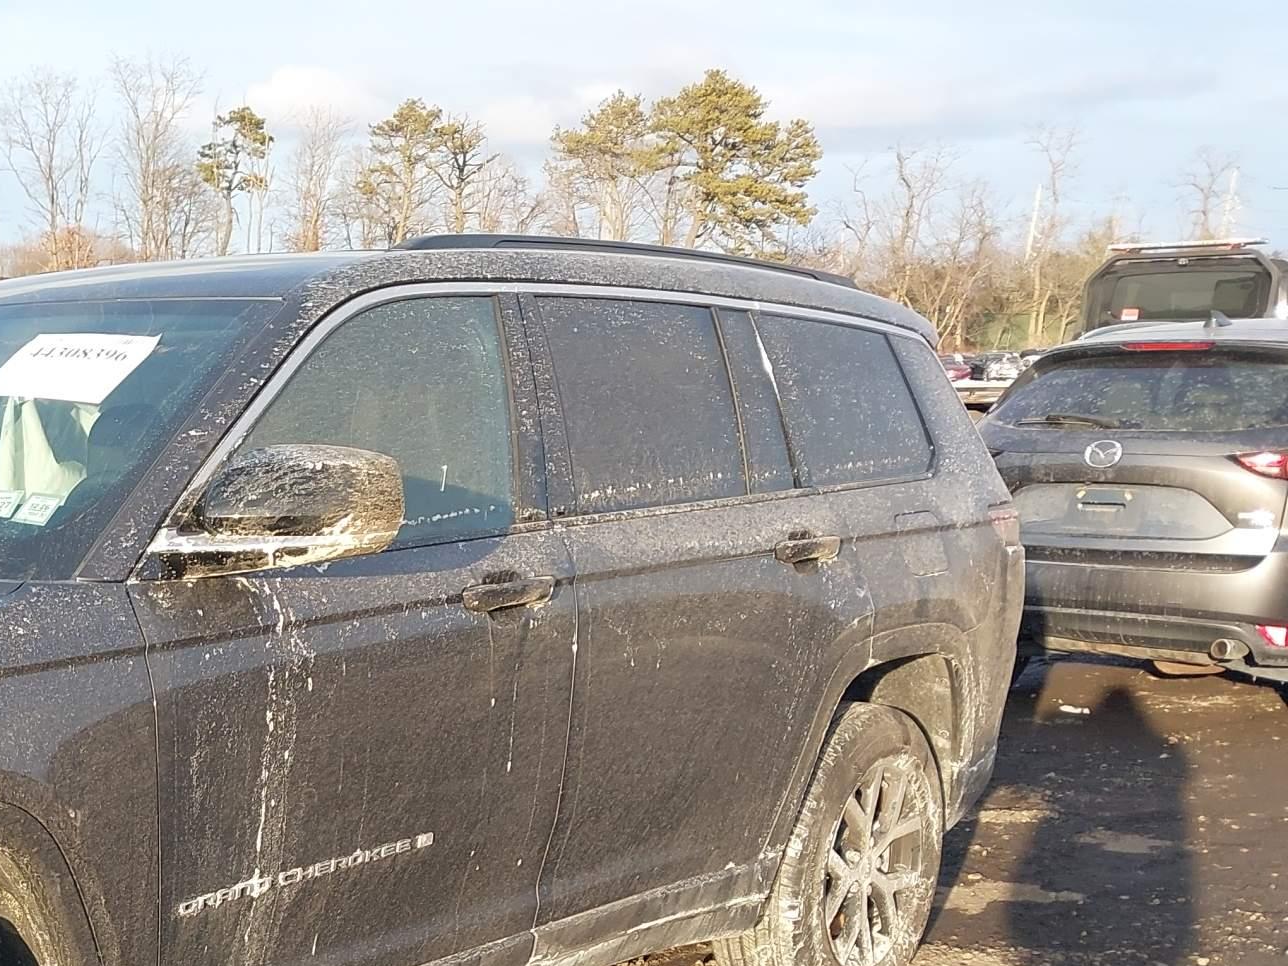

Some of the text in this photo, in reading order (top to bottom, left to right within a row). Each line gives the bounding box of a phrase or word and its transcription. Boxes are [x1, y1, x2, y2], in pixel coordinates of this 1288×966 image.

[30, 347, 129, 362] 44308396
[179, 839, 412, 916] GRAND CHEROKEE
